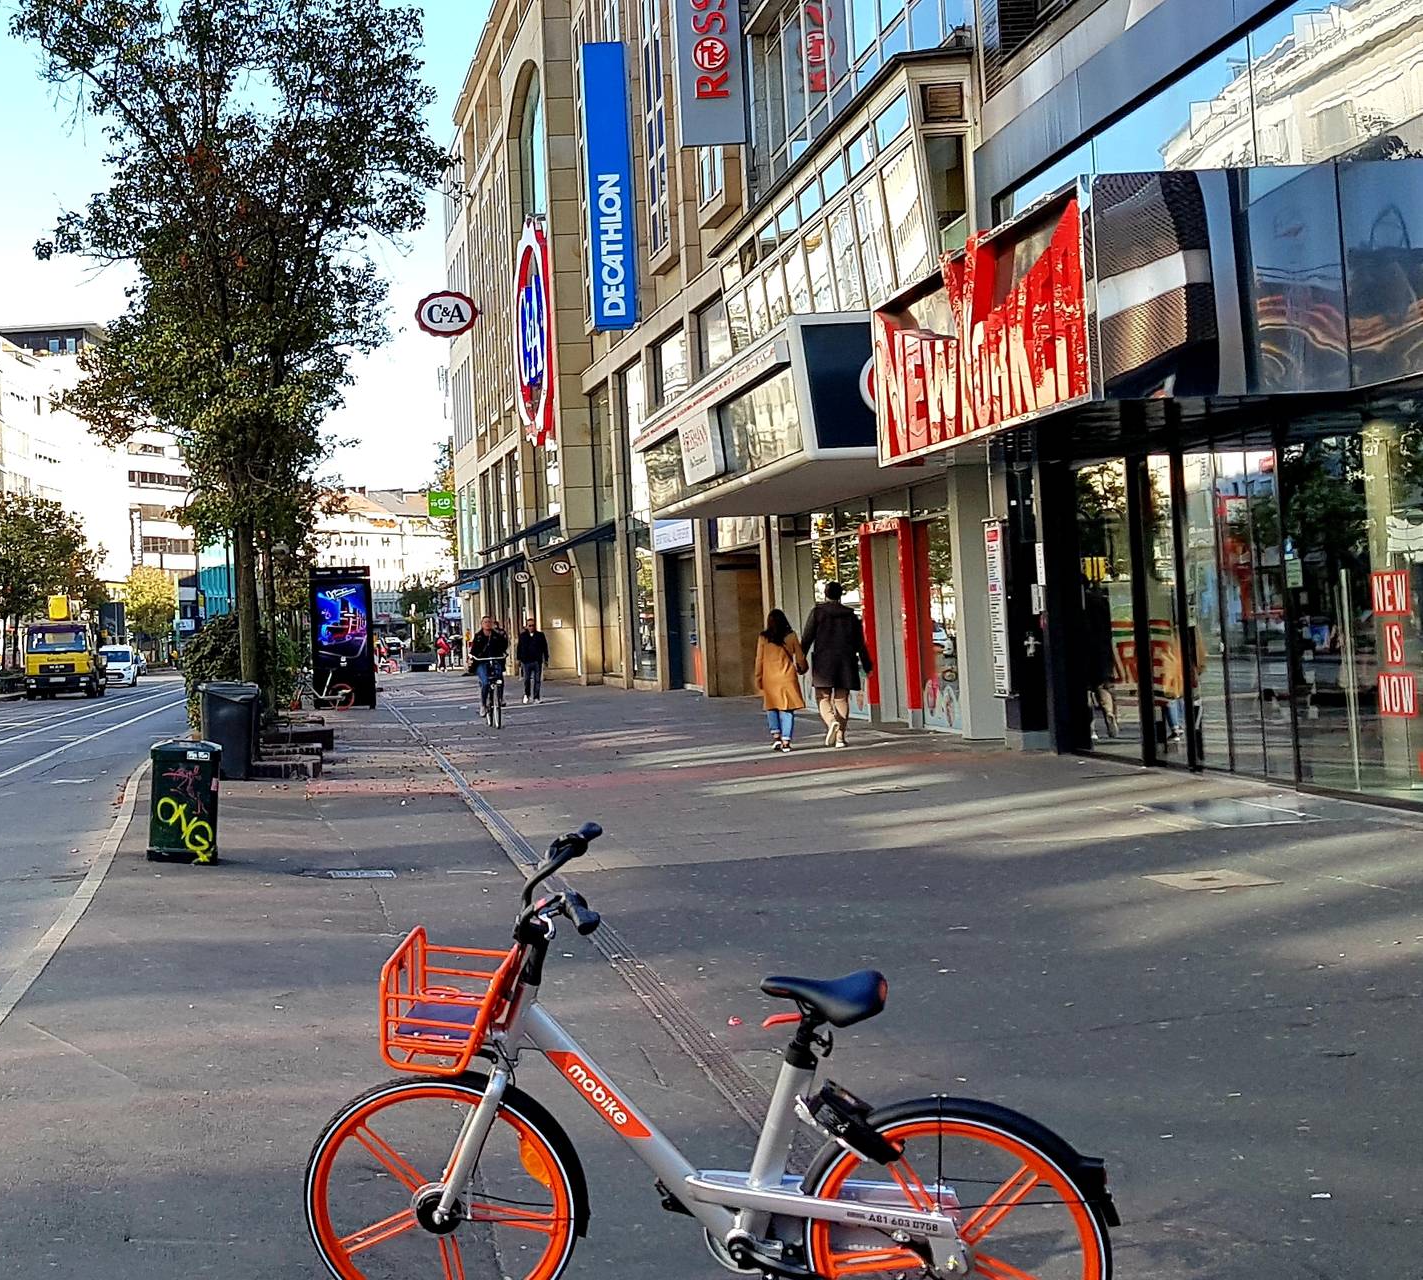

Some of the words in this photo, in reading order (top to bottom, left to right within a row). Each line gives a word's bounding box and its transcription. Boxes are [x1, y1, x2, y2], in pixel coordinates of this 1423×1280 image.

[597, 173, 627, 317] DECATHLON
[427, 303, 467, 324] C&A
[1372, 574, 1407, 612] NEW
[1386, 624, 1402, 663] IS
[1379, 675, 1415, 714] NOW
[568, 1064, 627, 1125] mobike
